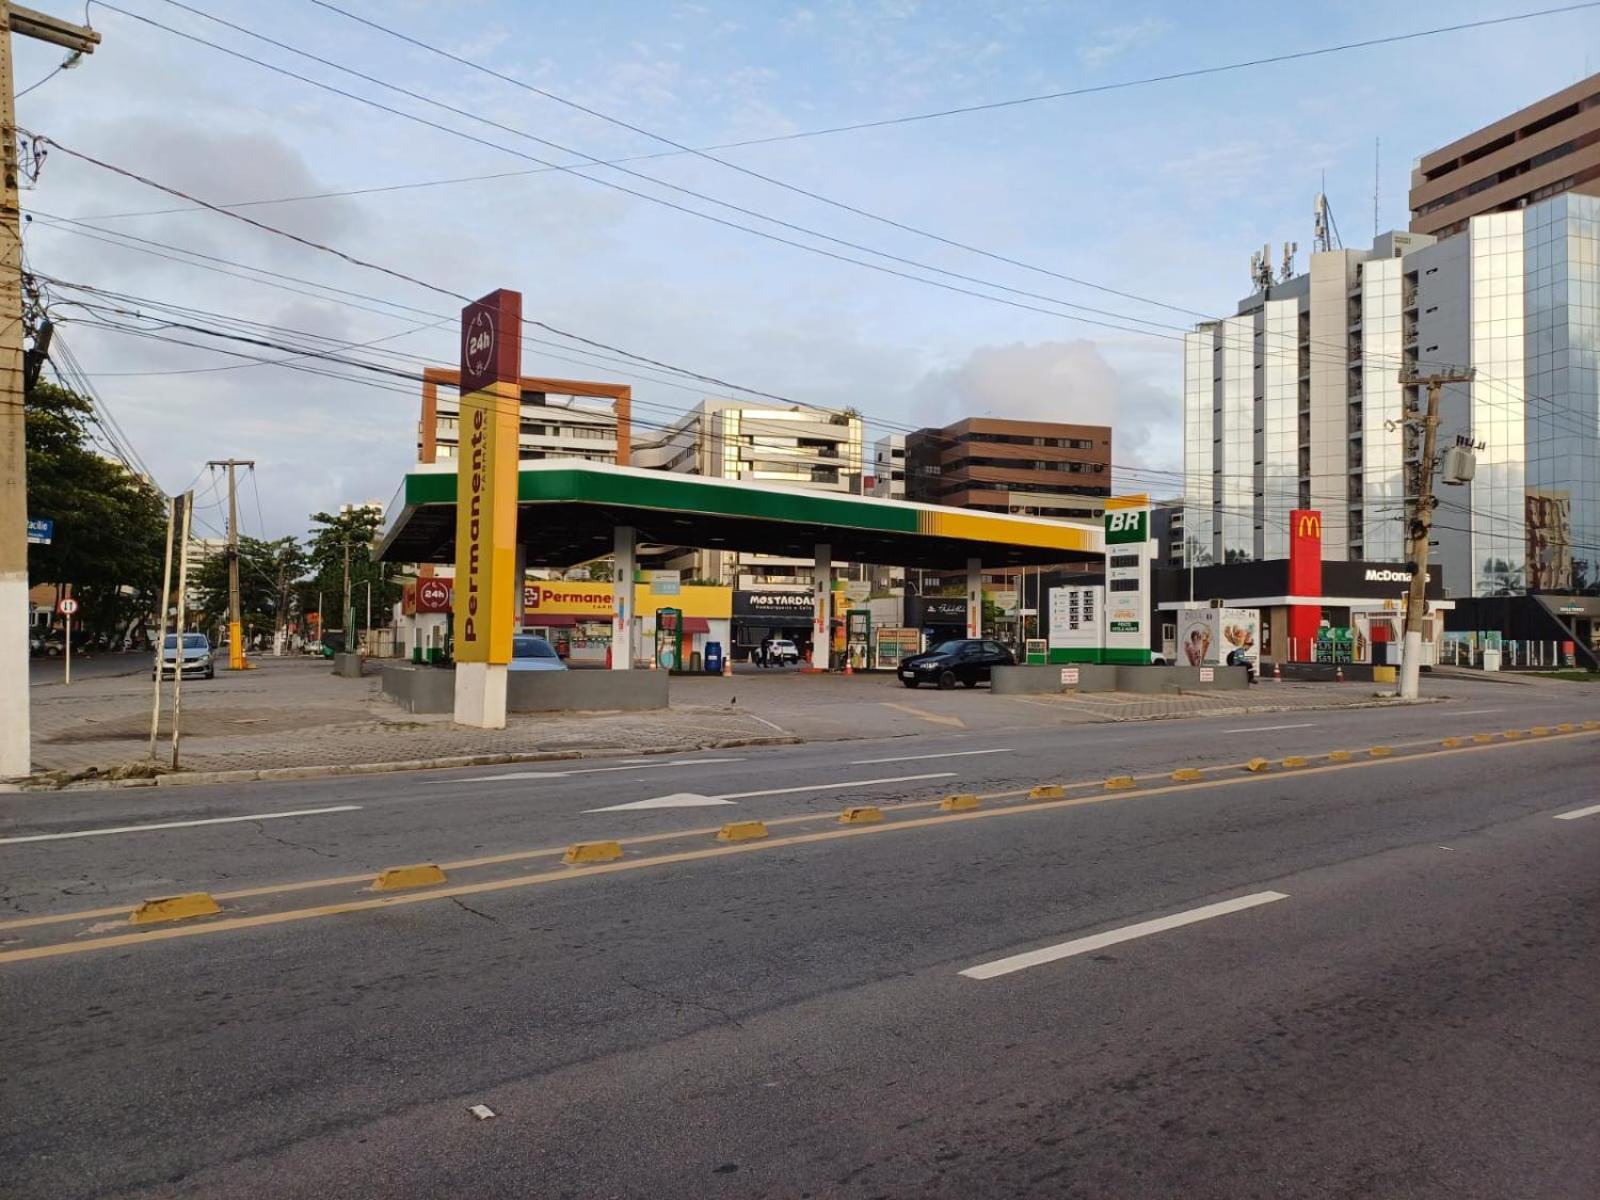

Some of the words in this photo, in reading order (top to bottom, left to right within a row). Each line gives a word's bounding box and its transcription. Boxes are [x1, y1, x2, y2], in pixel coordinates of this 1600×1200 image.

[469, 331, 490, 355] 24h
[465, 409, 483, 642] Permanente
[1109, 511, 1140, 532] BR
[1365, 569, 1431, 583] McDonas
[424, 590, 445, 598] 24h
[542, 590, 614, 603] Permane
